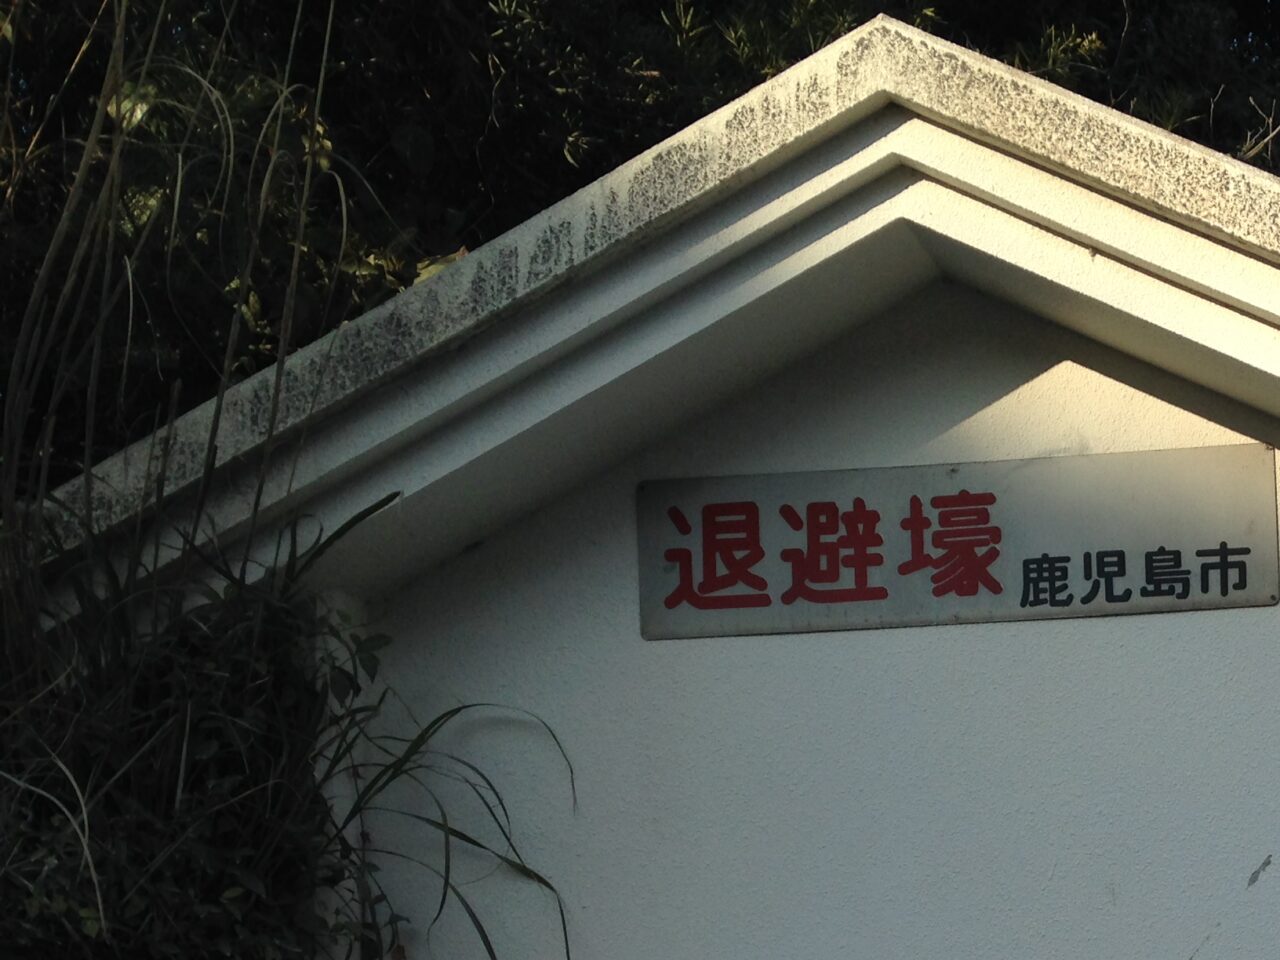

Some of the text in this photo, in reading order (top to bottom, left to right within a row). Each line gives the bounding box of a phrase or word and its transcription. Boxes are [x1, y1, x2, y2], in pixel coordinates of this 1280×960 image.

[663, 488, 1252, 610] 退避壕 鹿児島市
